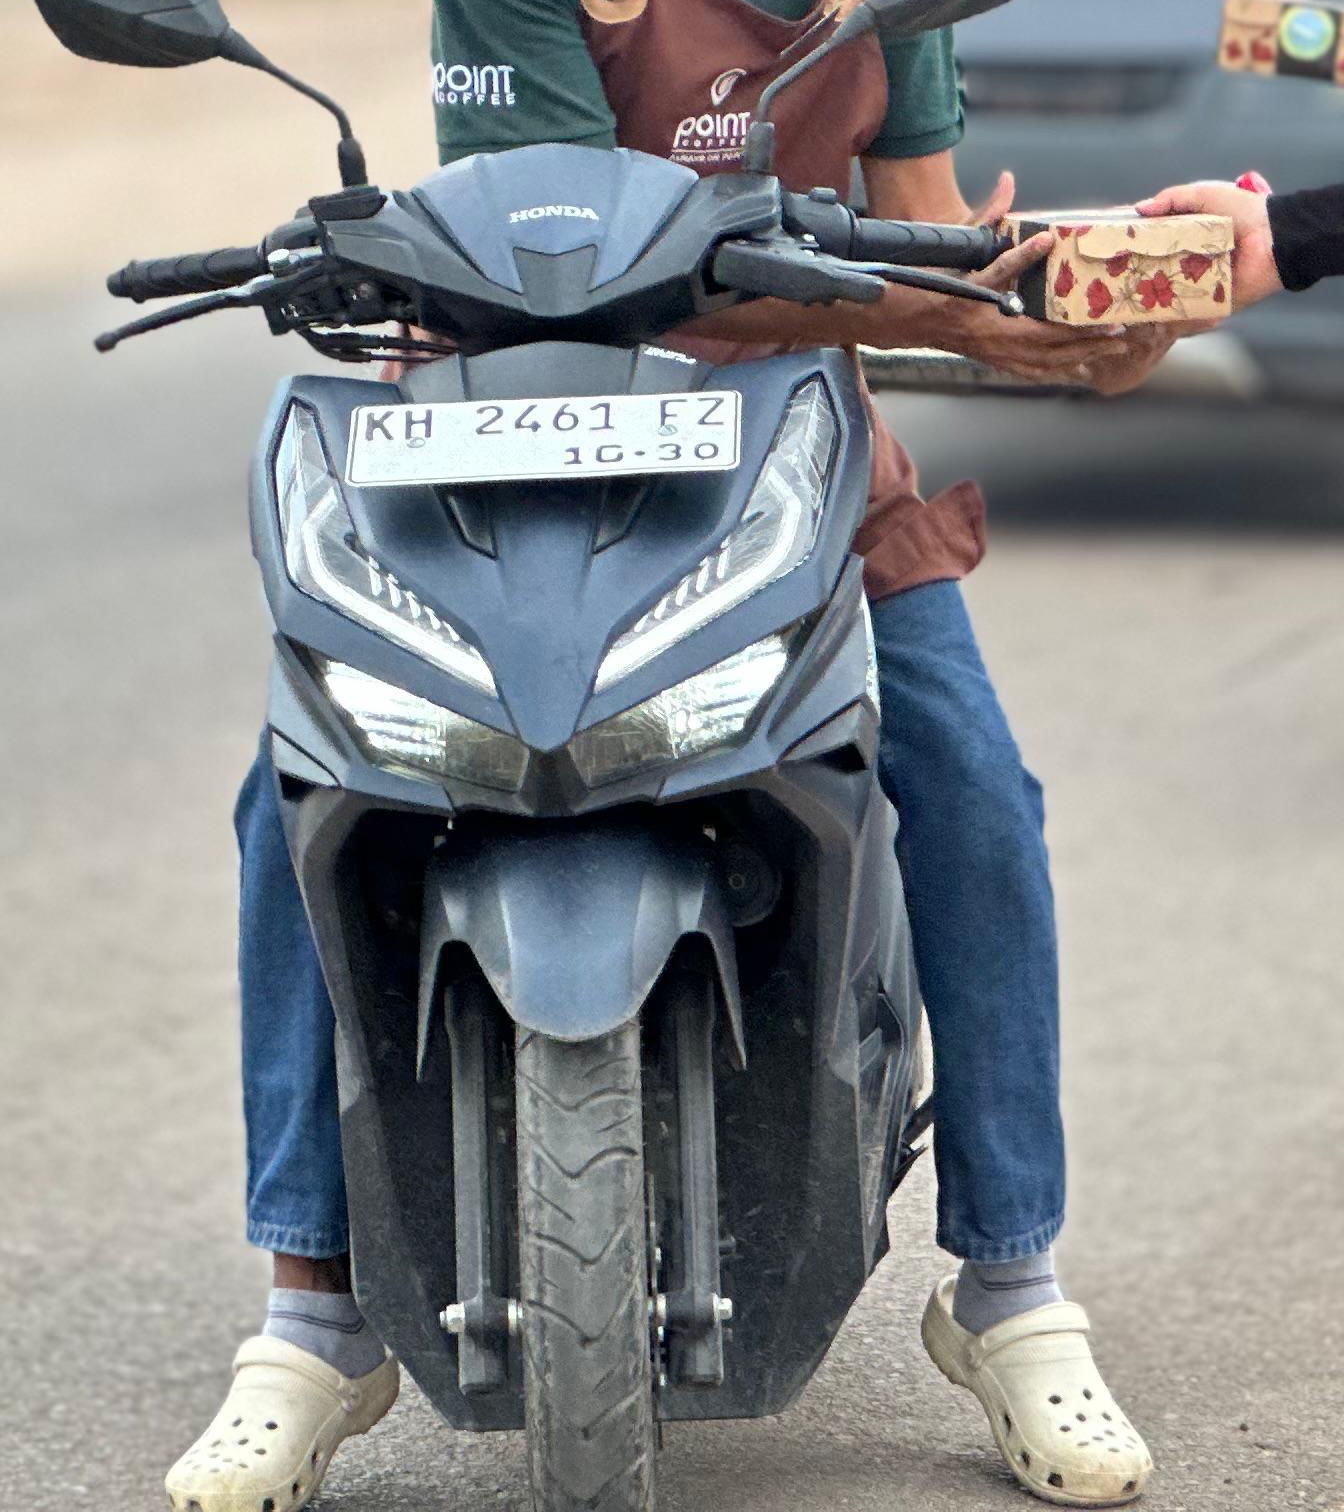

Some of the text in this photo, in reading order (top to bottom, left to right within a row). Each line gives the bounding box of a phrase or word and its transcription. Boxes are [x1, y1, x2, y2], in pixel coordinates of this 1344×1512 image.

[438, 91, 516, 106] COFFEE
[509, 205, 600, 224] HONDA
[365, 409, 433, 442] KH
[475, 402, 615, 435] 2461
